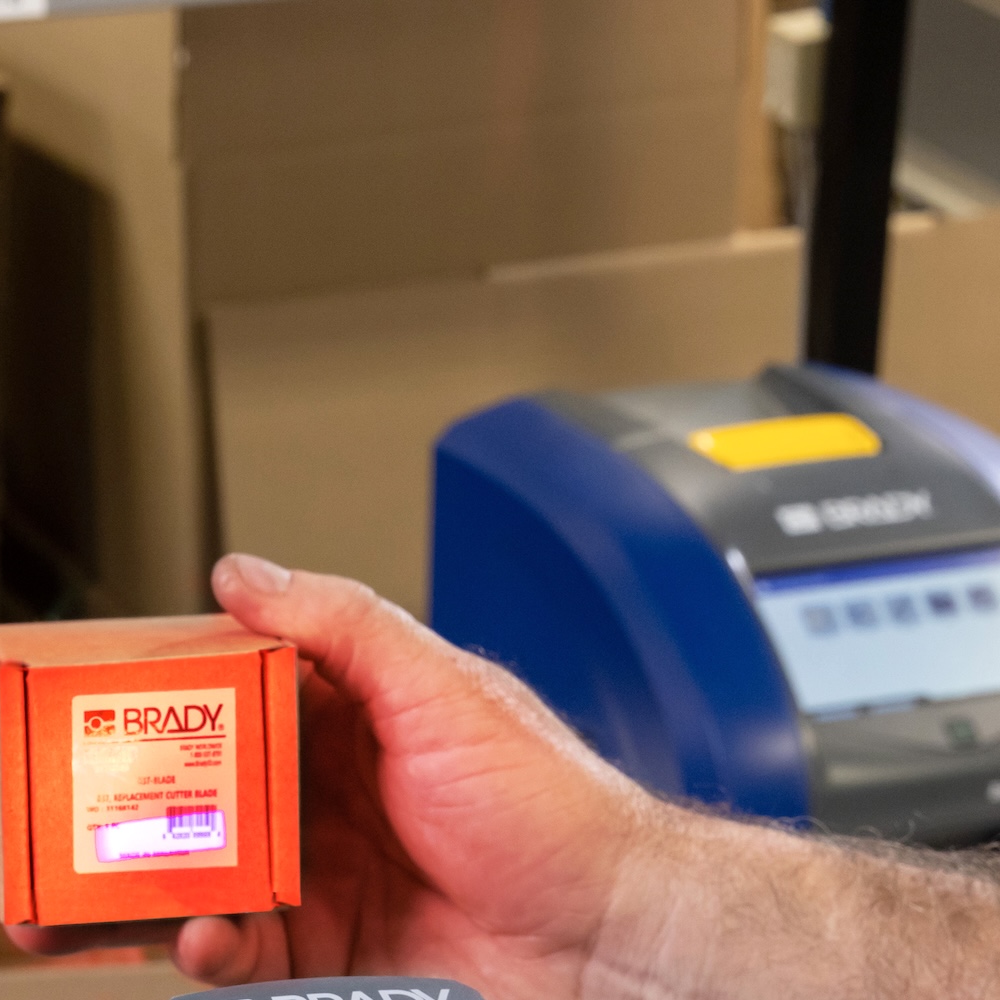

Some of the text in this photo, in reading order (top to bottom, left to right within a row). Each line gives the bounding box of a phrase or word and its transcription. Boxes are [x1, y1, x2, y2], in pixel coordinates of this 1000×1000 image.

[124, 704, 223, 735] BRADY
[114, 791, 163, 801] REPLACEMENT
[166, 790, 192, 800] CUTTER
[195, 789, 217, 798] BLADE
